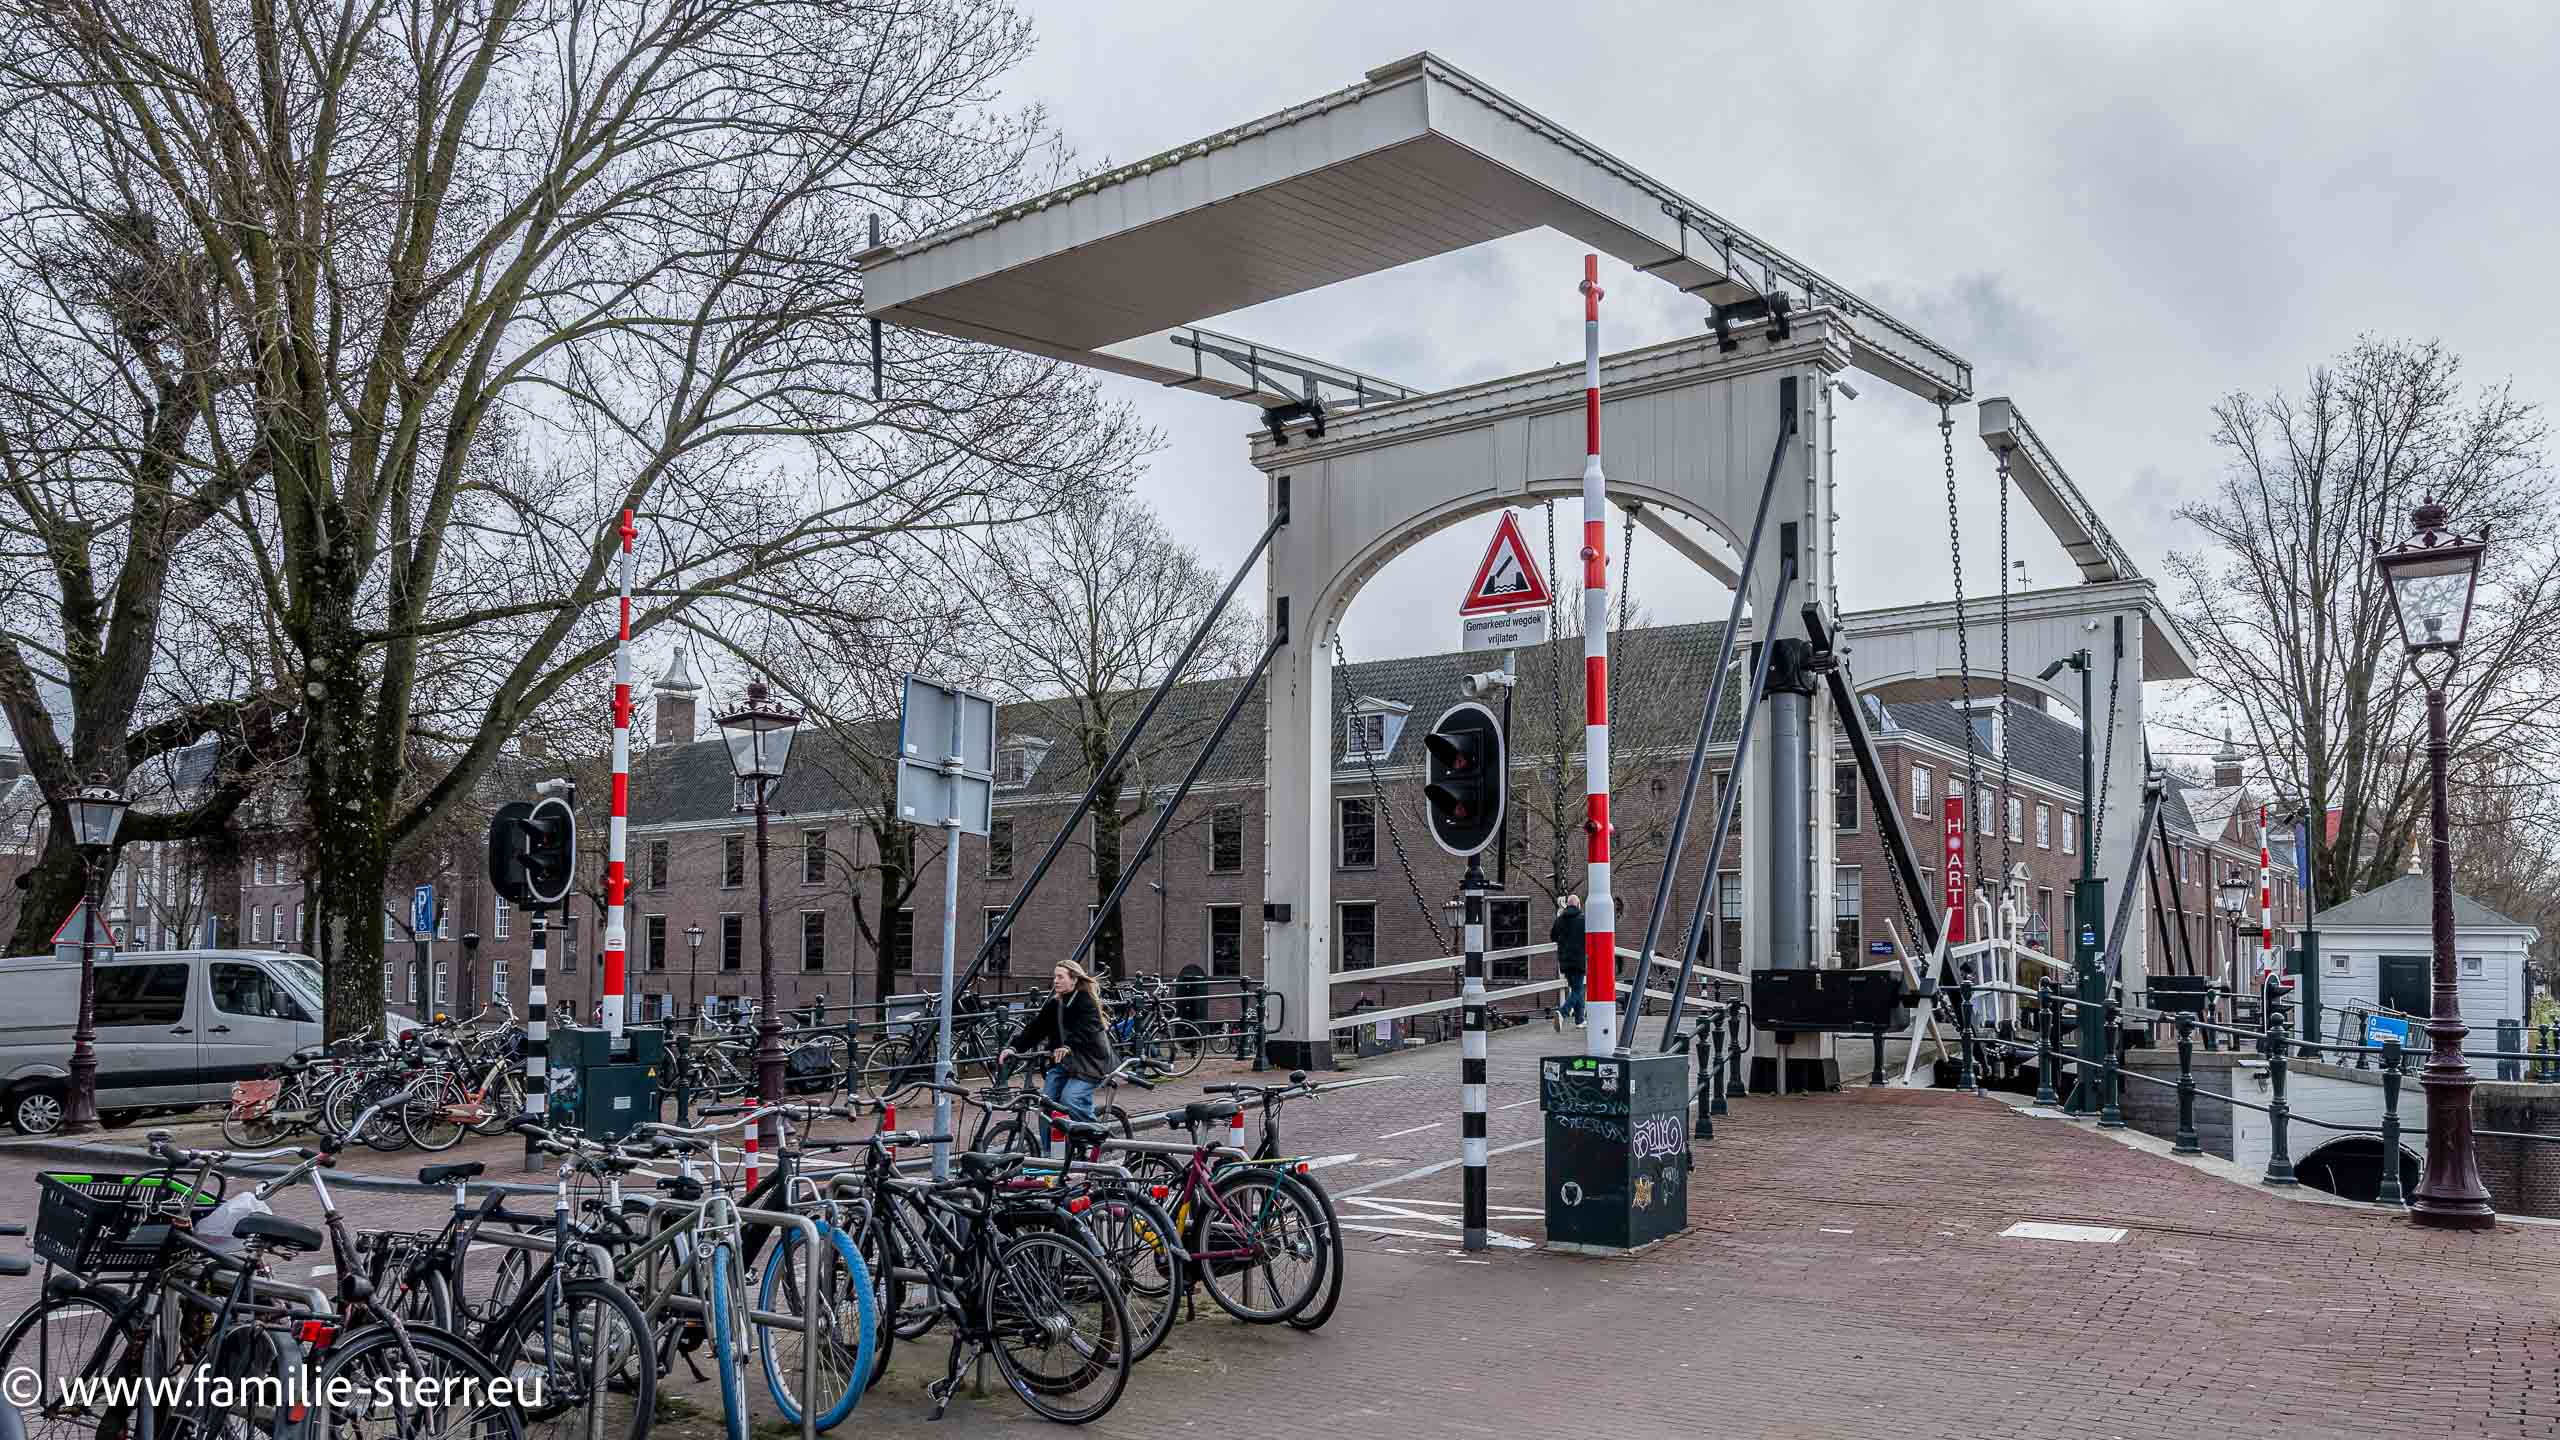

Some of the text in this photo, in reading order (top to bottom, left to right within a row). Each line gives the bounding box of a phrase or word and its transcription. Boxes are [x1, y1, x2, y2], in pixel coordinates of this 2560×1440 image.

[1466, 614, 1542, 632] Gemarkeerd wegdek
[1488, 633, 1518, 646] vrijlaten
